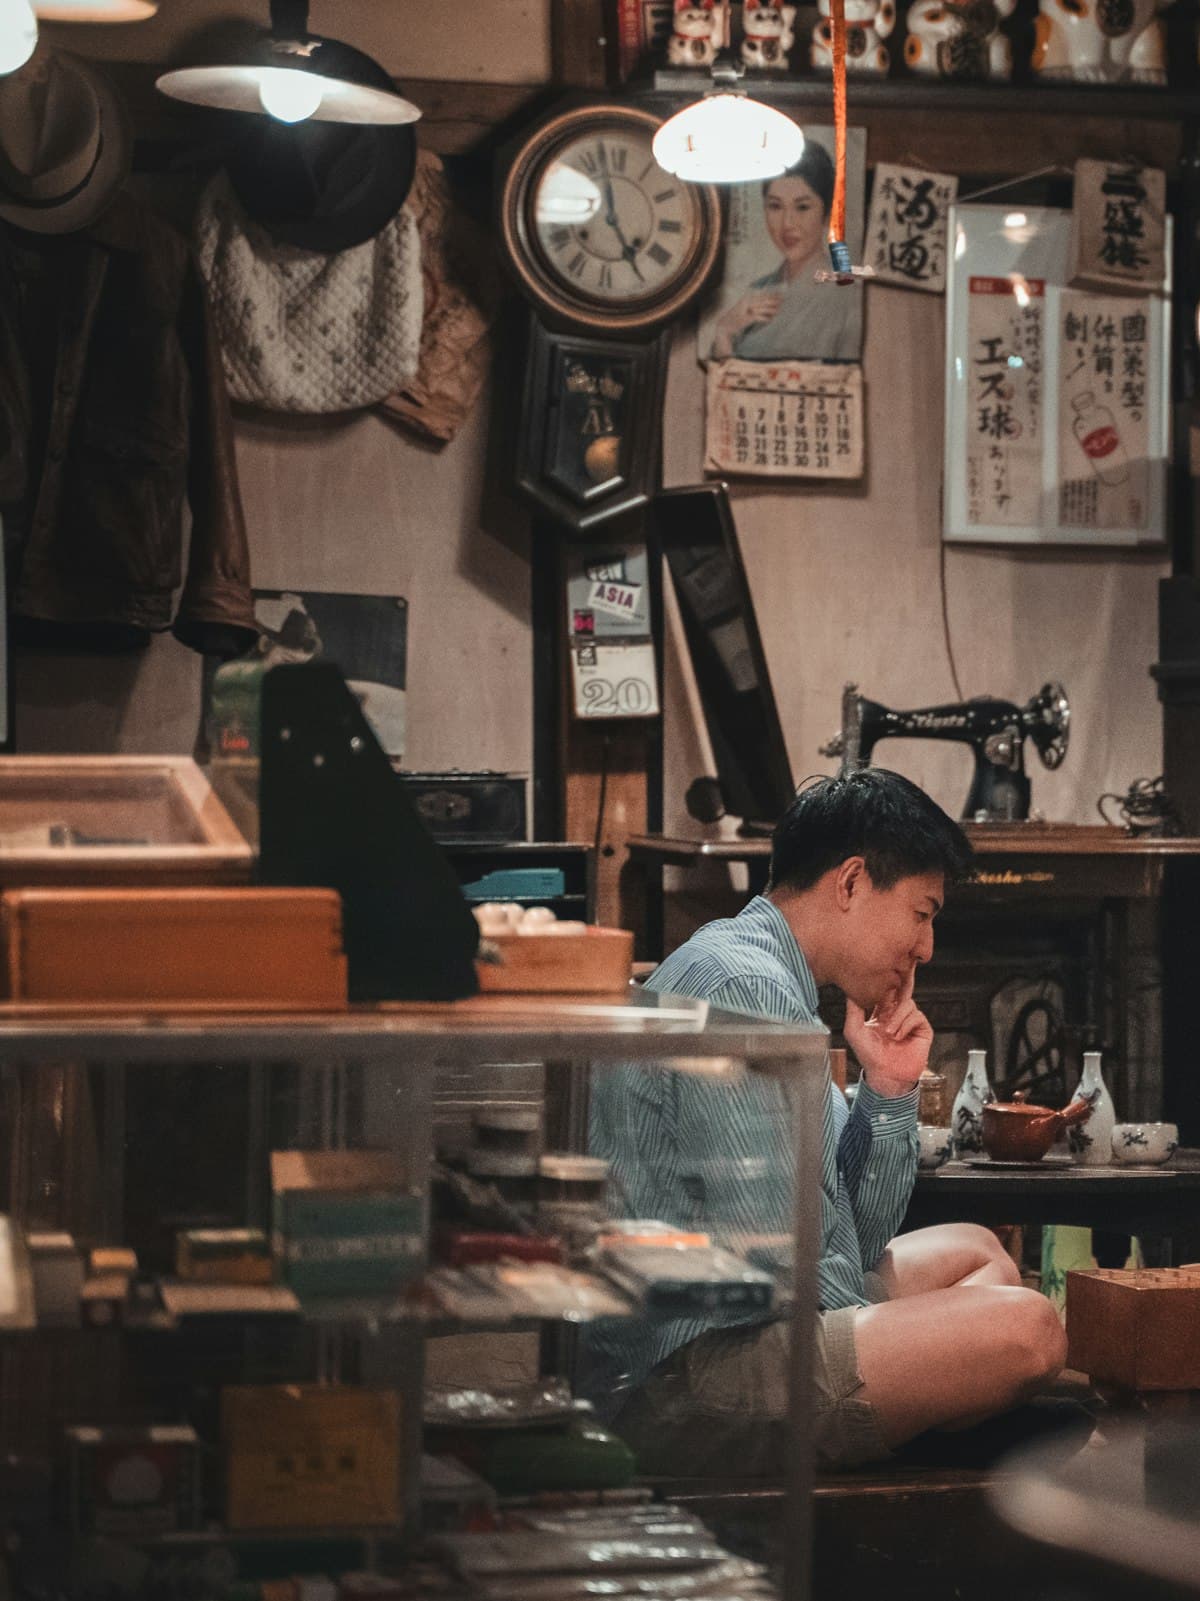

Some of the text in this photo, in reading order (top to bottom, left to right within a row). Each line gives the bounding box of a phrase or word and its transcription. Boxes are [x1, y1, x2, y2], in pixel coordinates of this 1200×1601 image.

[815, 412, 829, 424] 10
[594, 584, 635, 609] ASIA
[582, 677, 651, 716] 20
